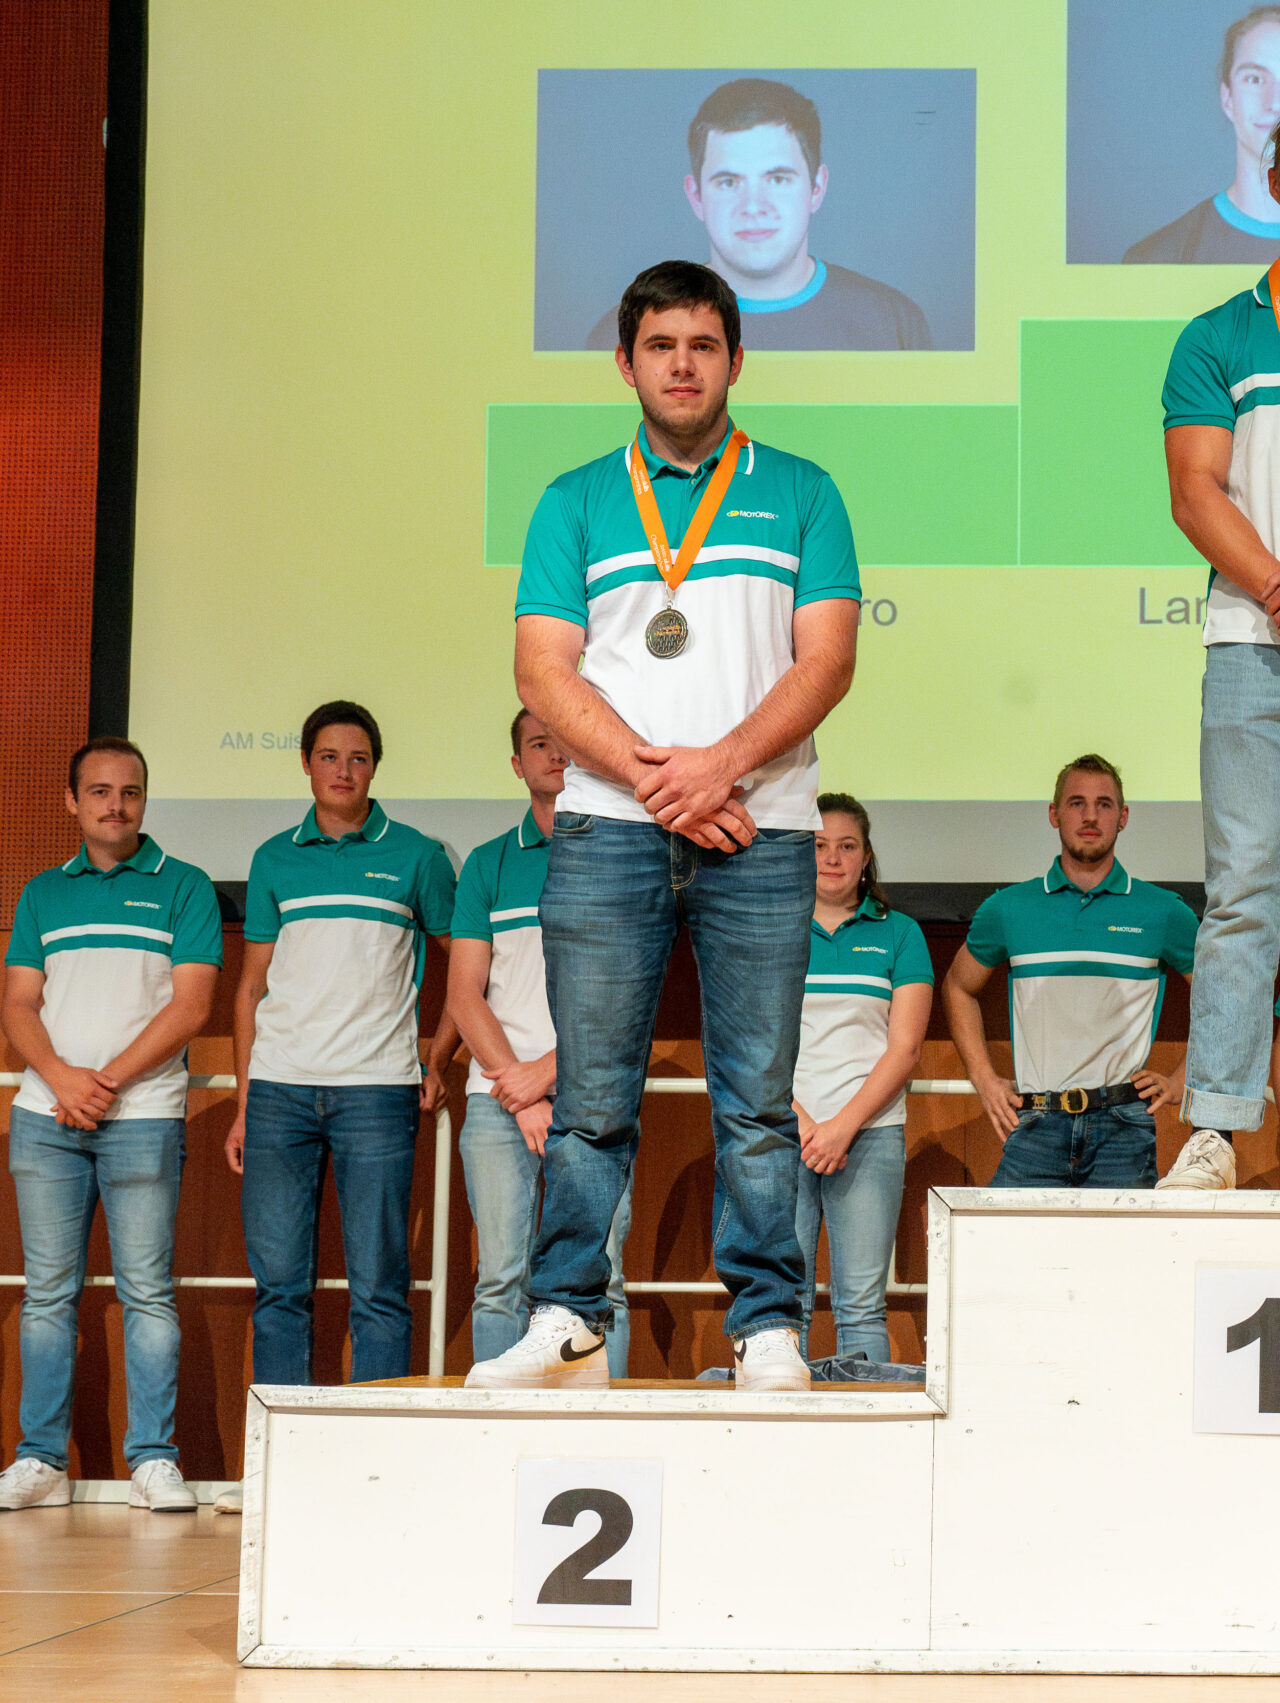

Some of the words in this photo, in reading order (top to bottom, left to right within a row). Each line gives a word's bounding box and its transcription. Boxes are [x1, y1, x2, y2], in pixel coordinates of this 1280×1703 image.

[739, 509, 776, 520] MOTOREX
[219, 731, 253, 750] AM
[260, 731, 302, 750] Suis
[536, 1488, 634, 1606] 2
